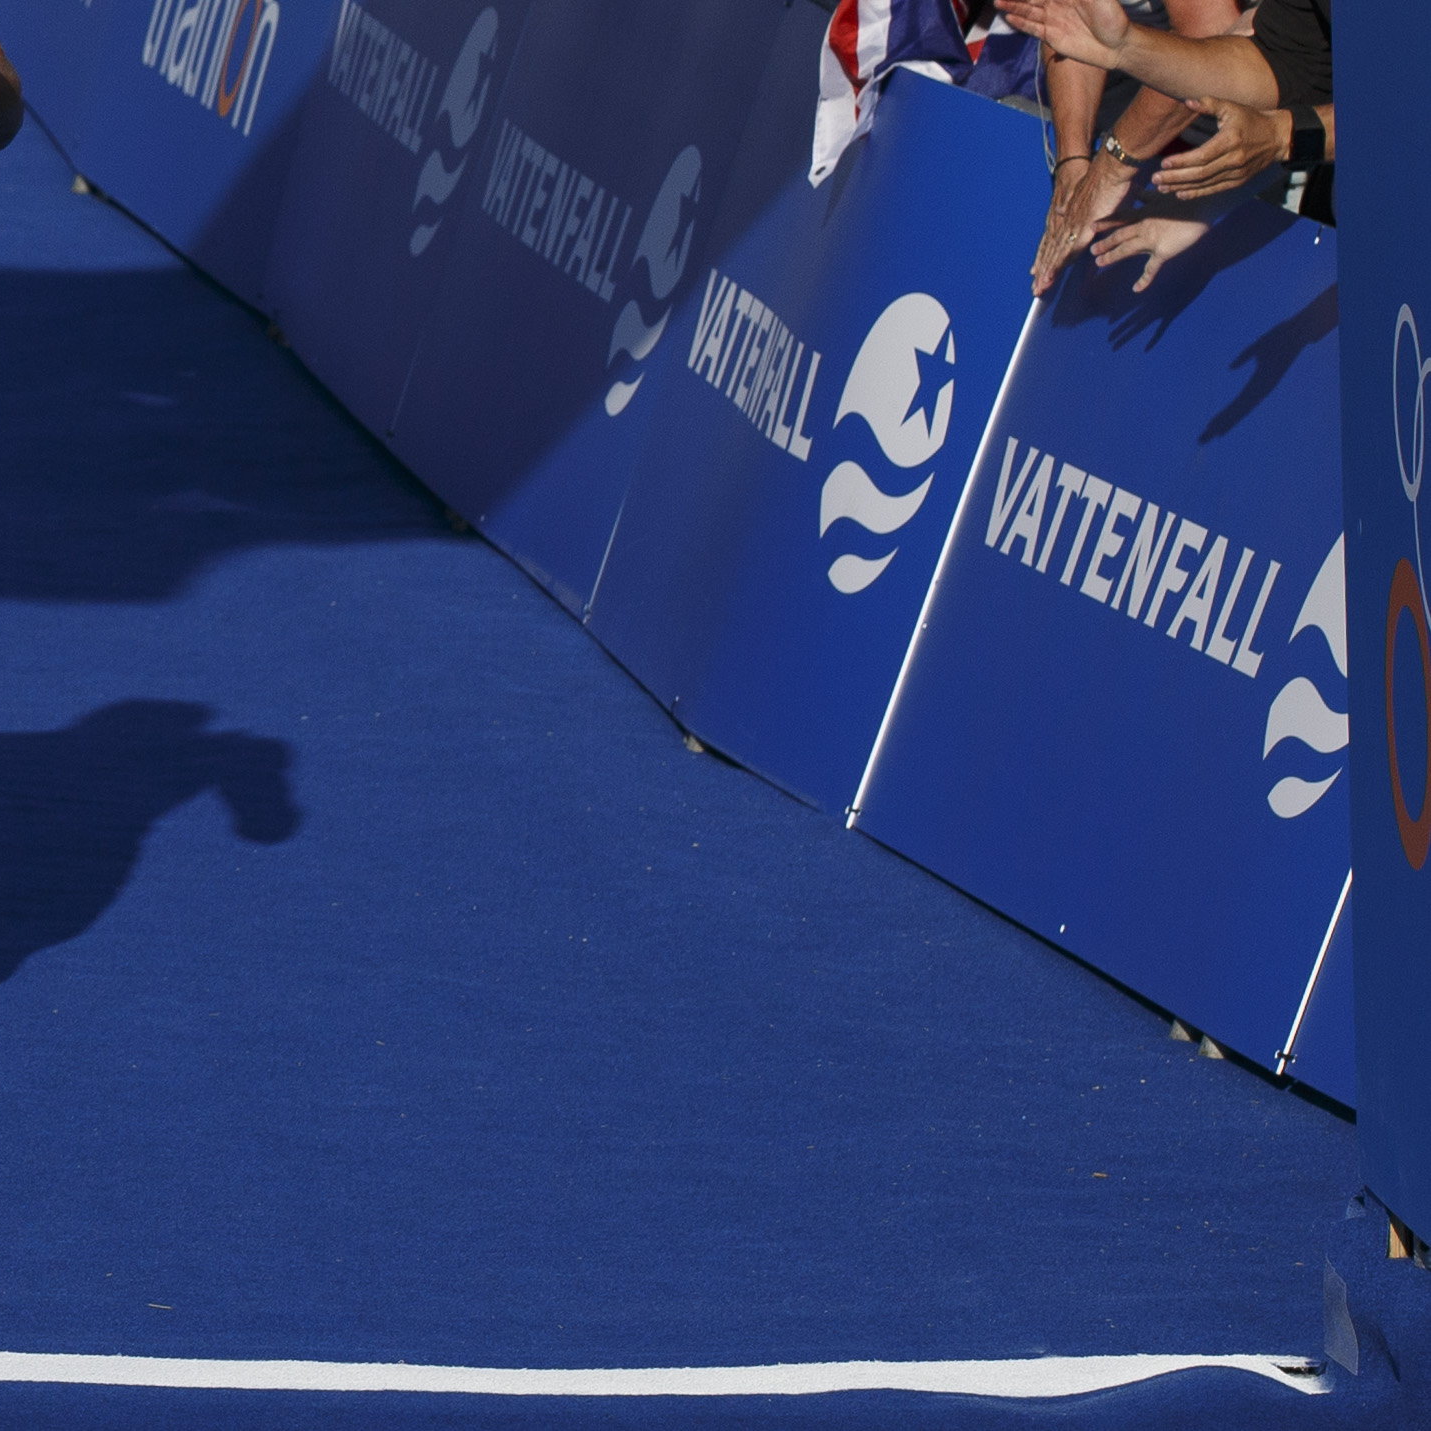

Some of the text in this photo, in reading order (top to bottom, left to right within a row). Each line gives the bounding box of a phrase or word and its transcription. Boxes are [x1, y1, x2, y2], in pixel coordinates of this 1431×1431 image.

[482, 119, 633, 303] VATTENFALL
[687, 267, 822, 462] VATTENFALL
[983, 435, 1283, 679] VATTENFALL
